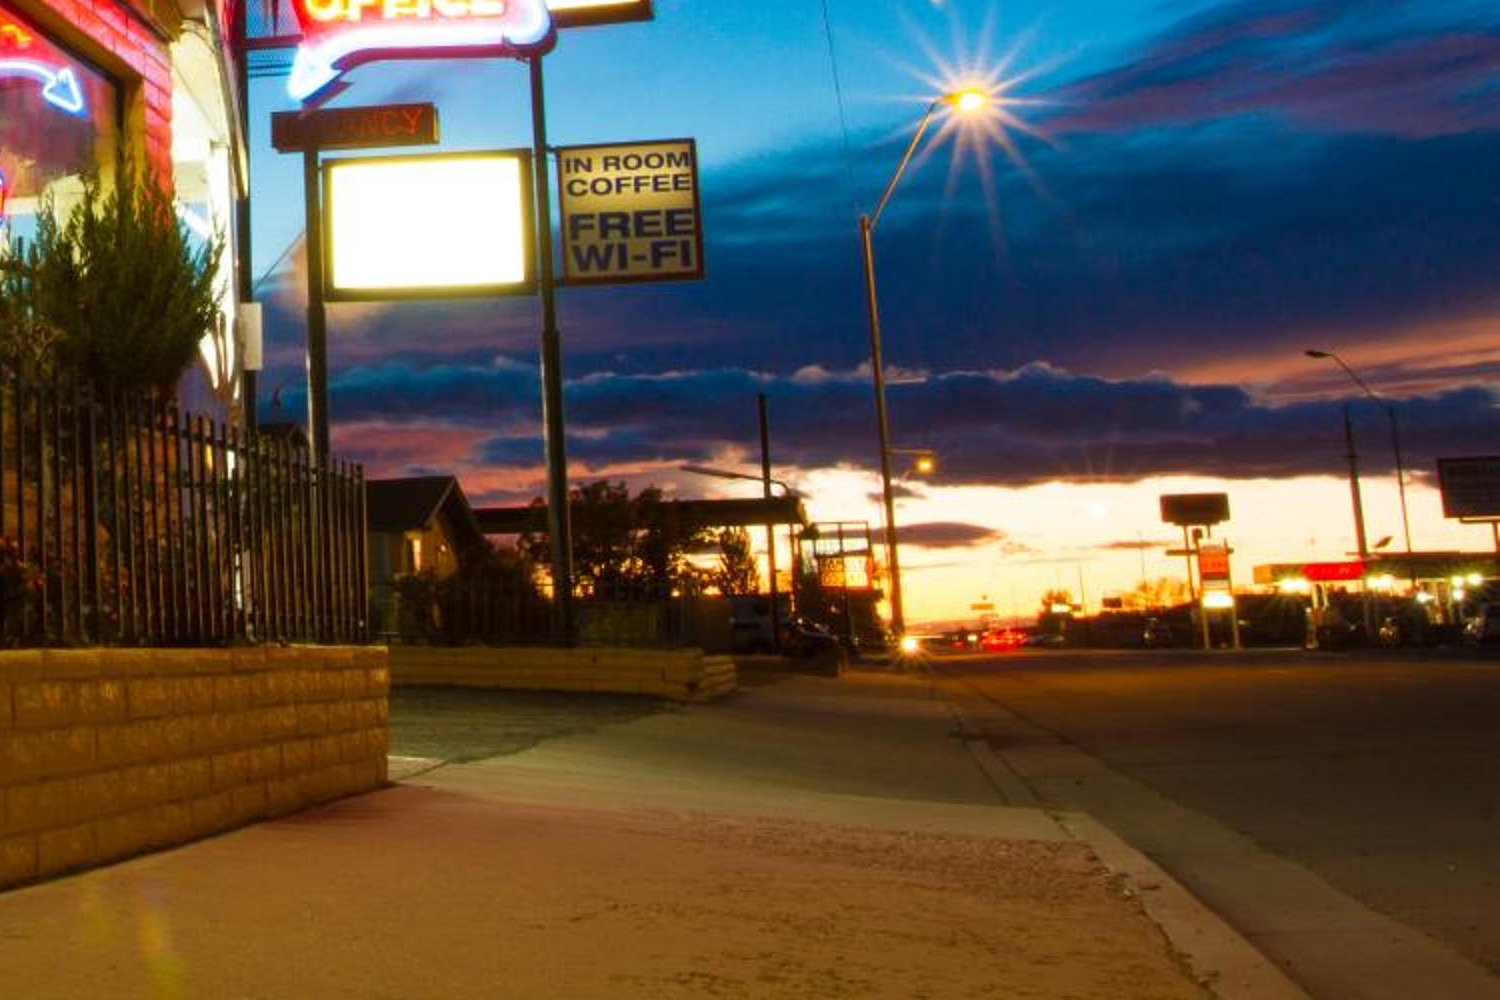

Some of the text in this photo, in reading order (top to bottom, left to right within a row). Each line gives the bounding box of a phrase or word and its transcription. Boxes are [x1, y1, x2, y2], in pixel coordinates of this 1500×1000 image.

[565, 152, 690, 174] IN ROOM
[567, 173, 692, 197] COFFEE
[569, 208, 693, 241] FREE
[570, 240, 692, 272] WI-FI
